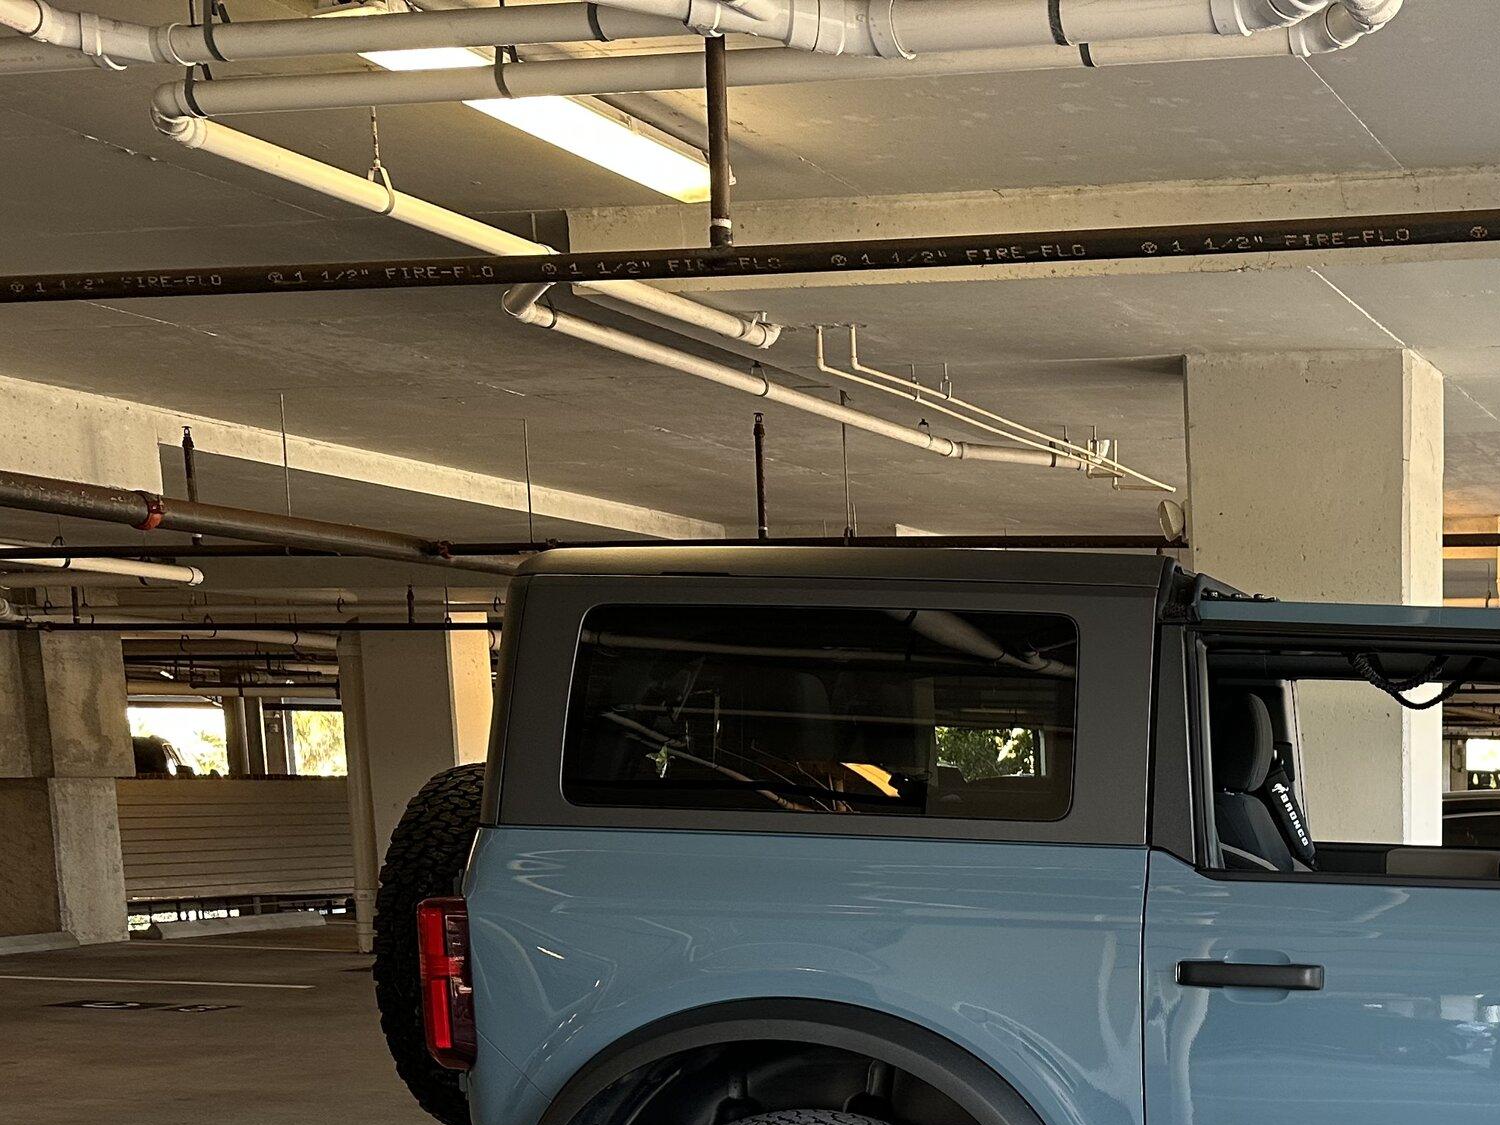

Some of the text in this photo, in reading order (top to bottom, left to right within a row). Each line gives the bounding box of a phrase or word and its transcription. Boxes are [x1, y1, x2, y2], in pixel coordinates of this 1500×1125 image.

[1203, 235, 1263, 250] 1/2"
[1284, 228, 1411, 247] FIRE-FLO
[965, 244, 1086, 262] FIRE-FLO
[667, 257, 782, 273] FIR-FLO
[1280, 793, 1309, 847] BRONCO
